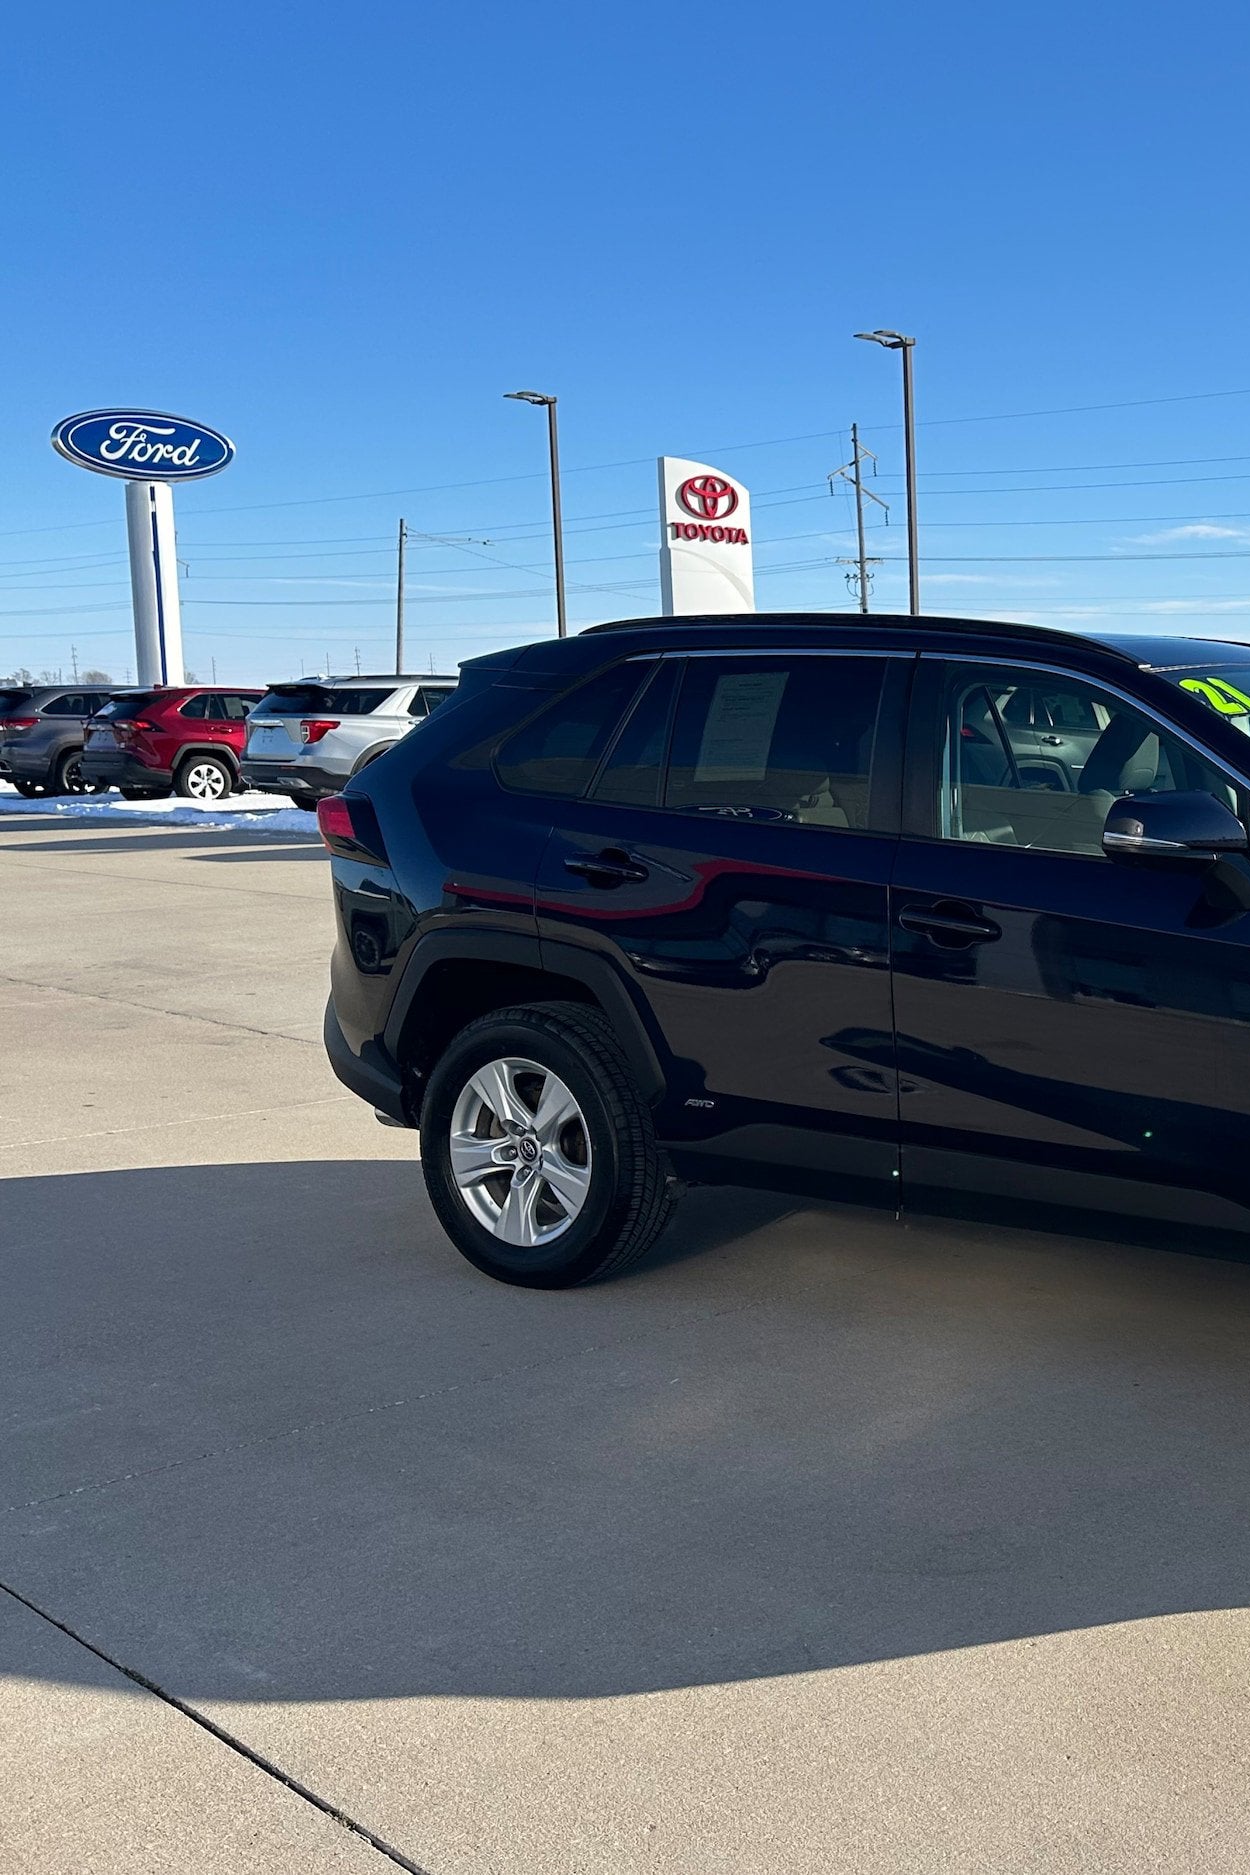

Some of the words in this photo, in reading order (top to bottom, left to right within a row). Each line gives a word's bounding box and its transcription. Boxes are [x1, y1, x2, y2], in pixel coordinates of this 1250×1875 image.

[100, 422, 201, 466] Ford
[669, 522, 749, 545] TOYOTA
[684, 1098, 714, 1108] AWD
